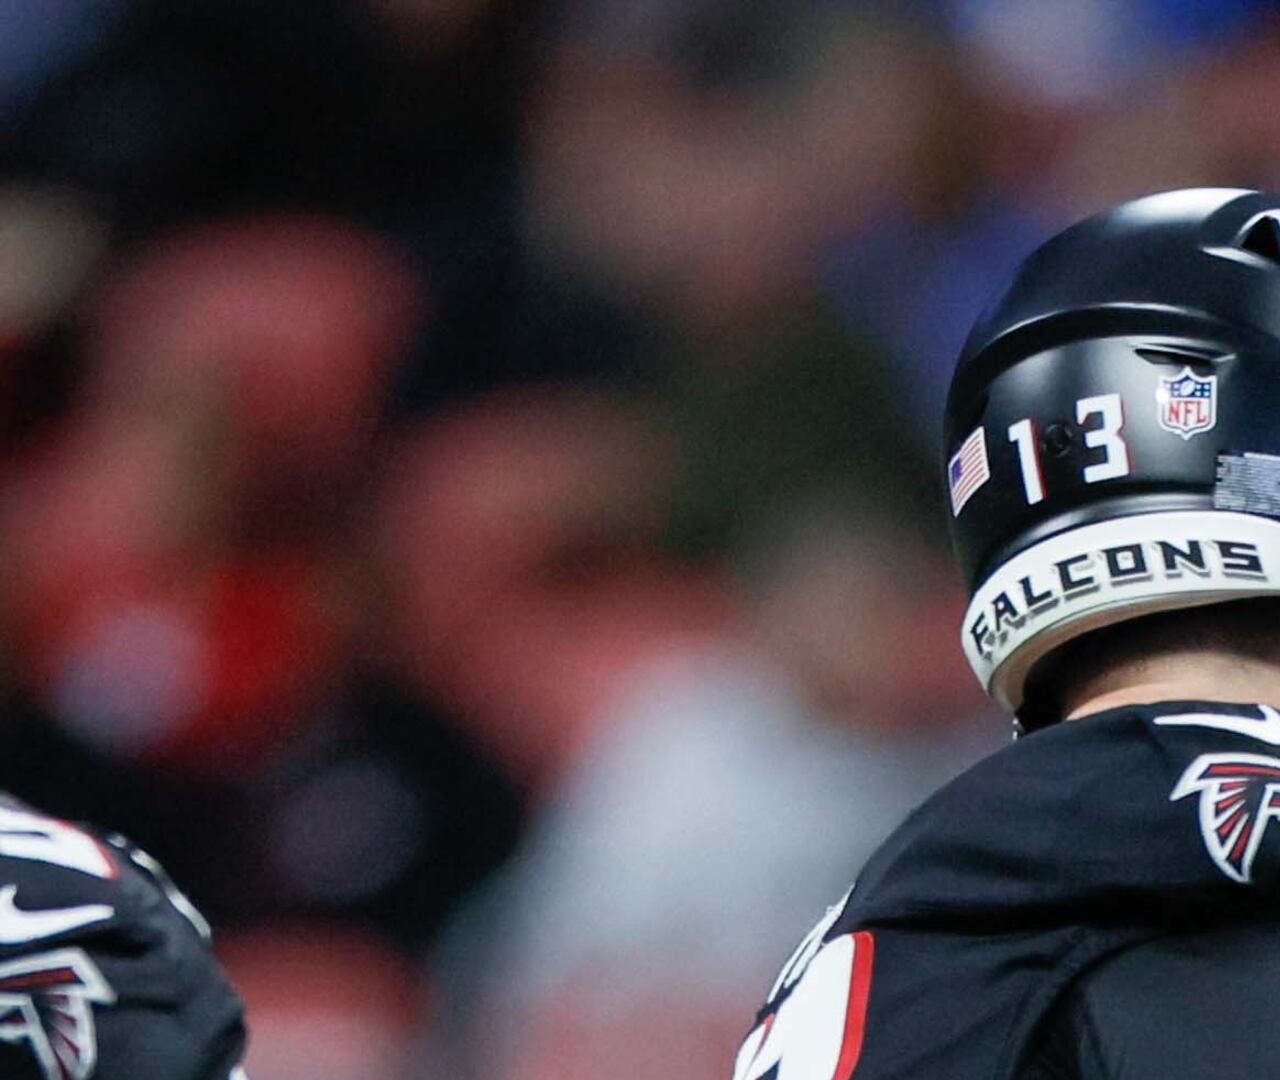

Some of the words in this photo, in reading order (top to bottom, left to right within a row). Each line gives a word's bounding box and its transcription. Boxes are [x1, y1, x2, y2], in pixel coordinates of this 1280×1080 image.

[1007, 393, 1132, 506] 13
[1167, 400, 1209, 427] NFL
[969, 539, 1268, 658] FALCONS
